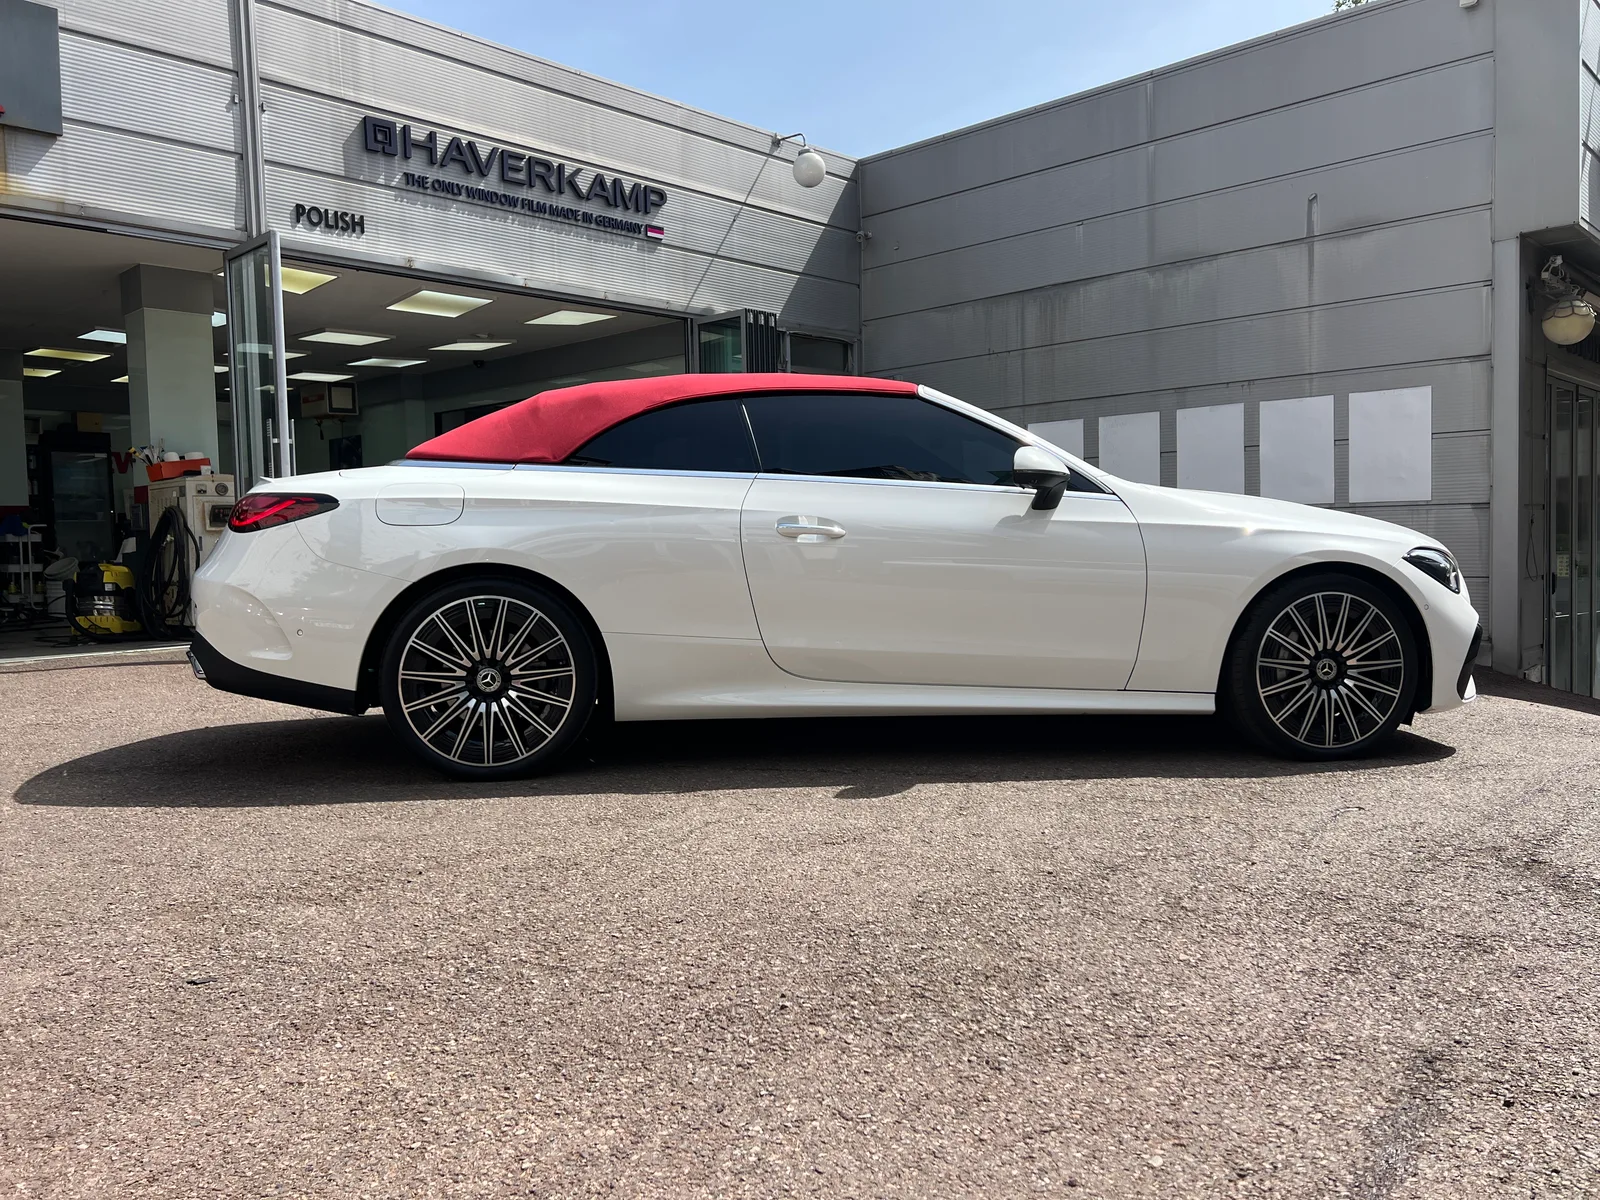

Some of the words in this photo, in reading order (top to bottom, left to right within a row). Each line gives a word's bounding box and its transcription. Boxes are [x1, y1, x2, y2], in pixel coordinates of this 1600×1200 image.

[403, 124, 668, 215] HAVERKAMP
[295, 203, 366, 235] POLISH
[403, 172, 429, 190] THE
[431, 179, 465, 197] ONLY
[465, 185, 520, 208] WINDOW
[521, 198, 547, 216] FILM
[549, 204, 581, 222] MADE
[582, 211, 594, 224] IN
[595, 215, 645, 235] GERMANY
